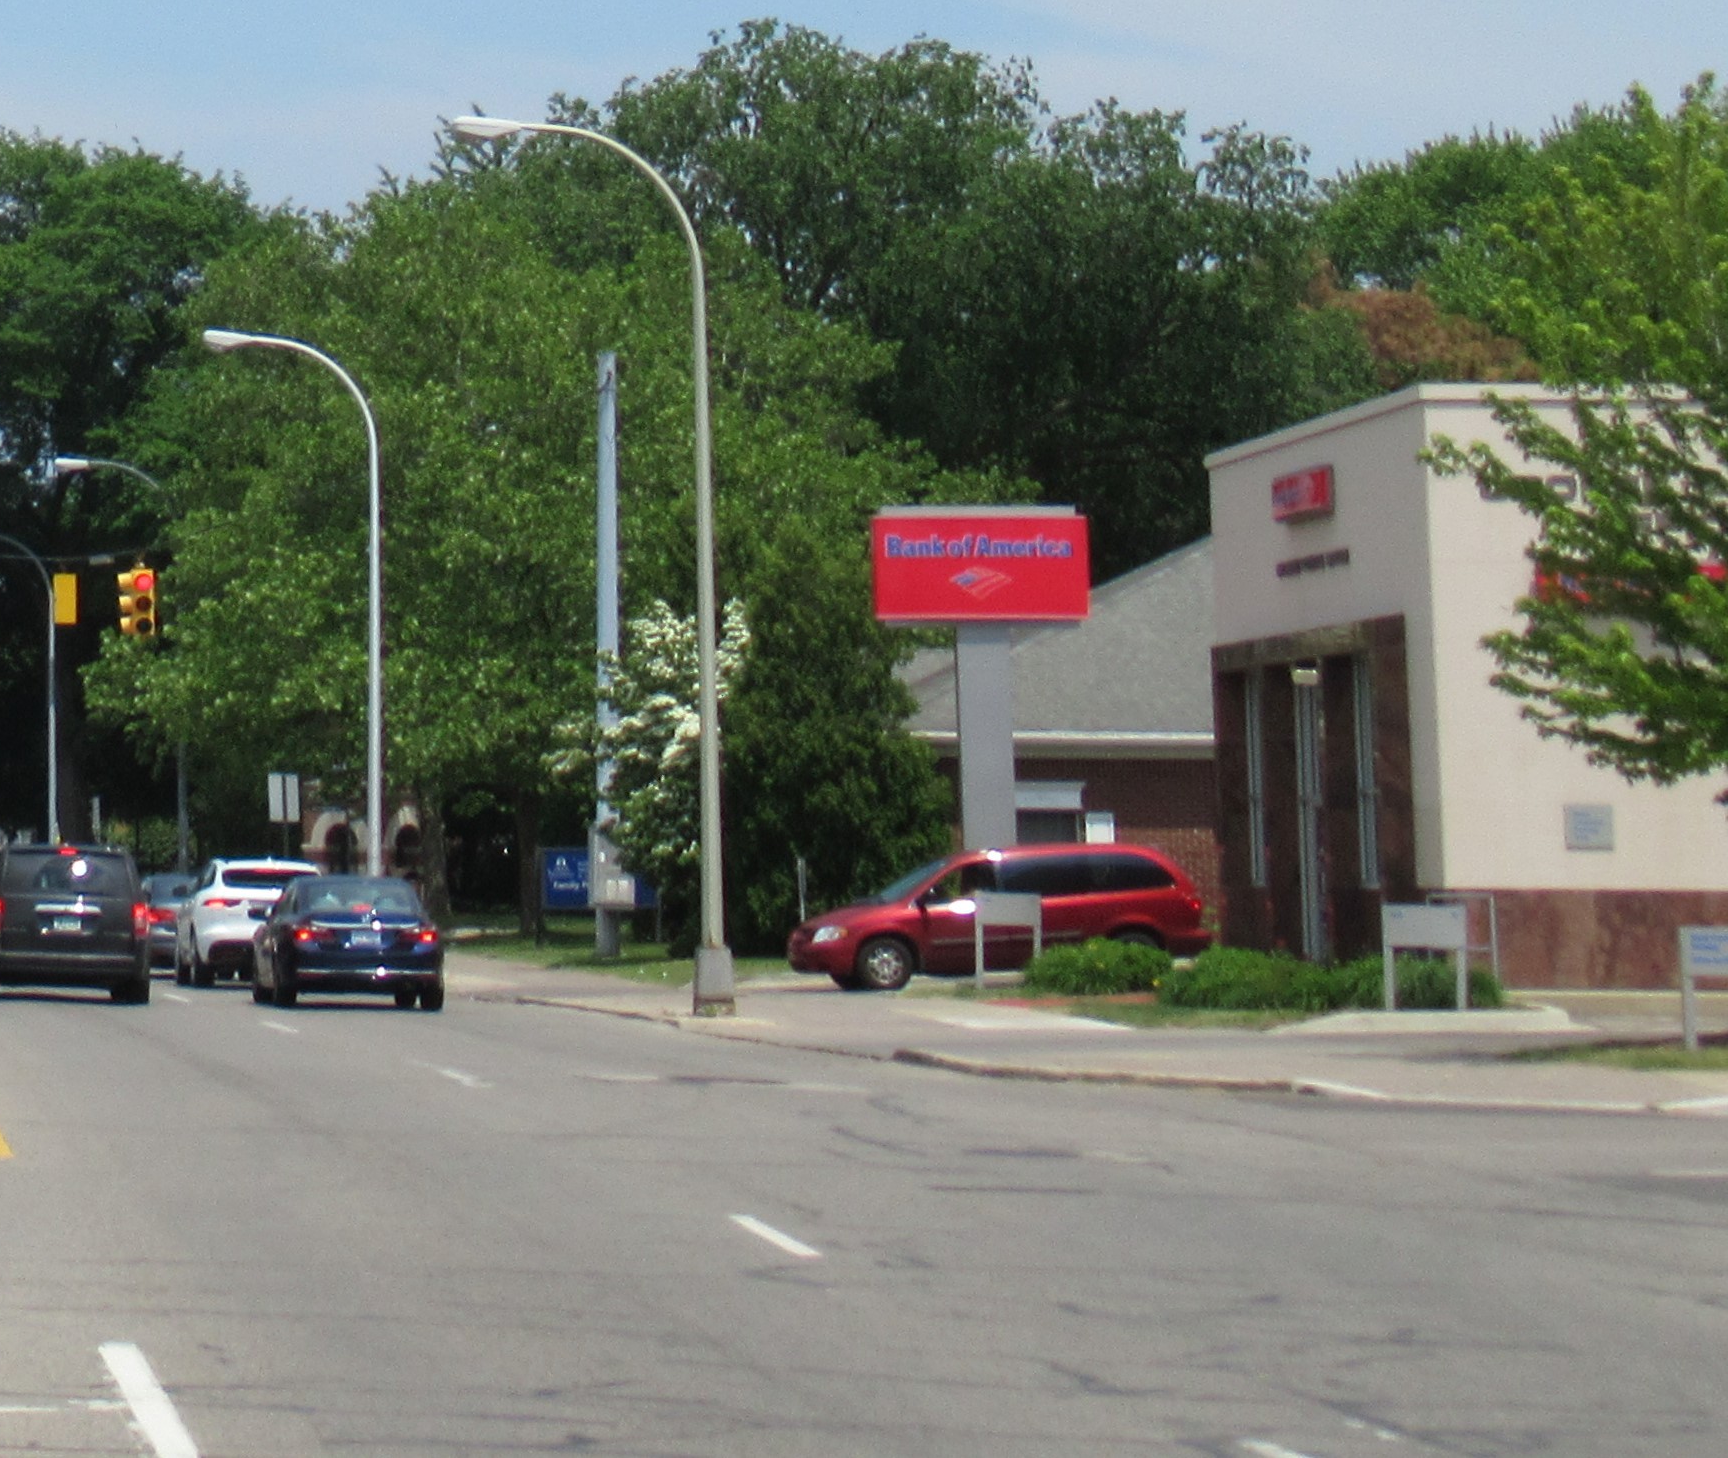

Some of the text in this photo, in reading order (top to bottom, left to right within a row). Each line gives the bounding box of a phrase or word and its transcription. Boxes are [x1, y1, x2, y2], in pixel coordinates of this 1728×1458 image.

[884, 533, 1073, 558] Bank of America
